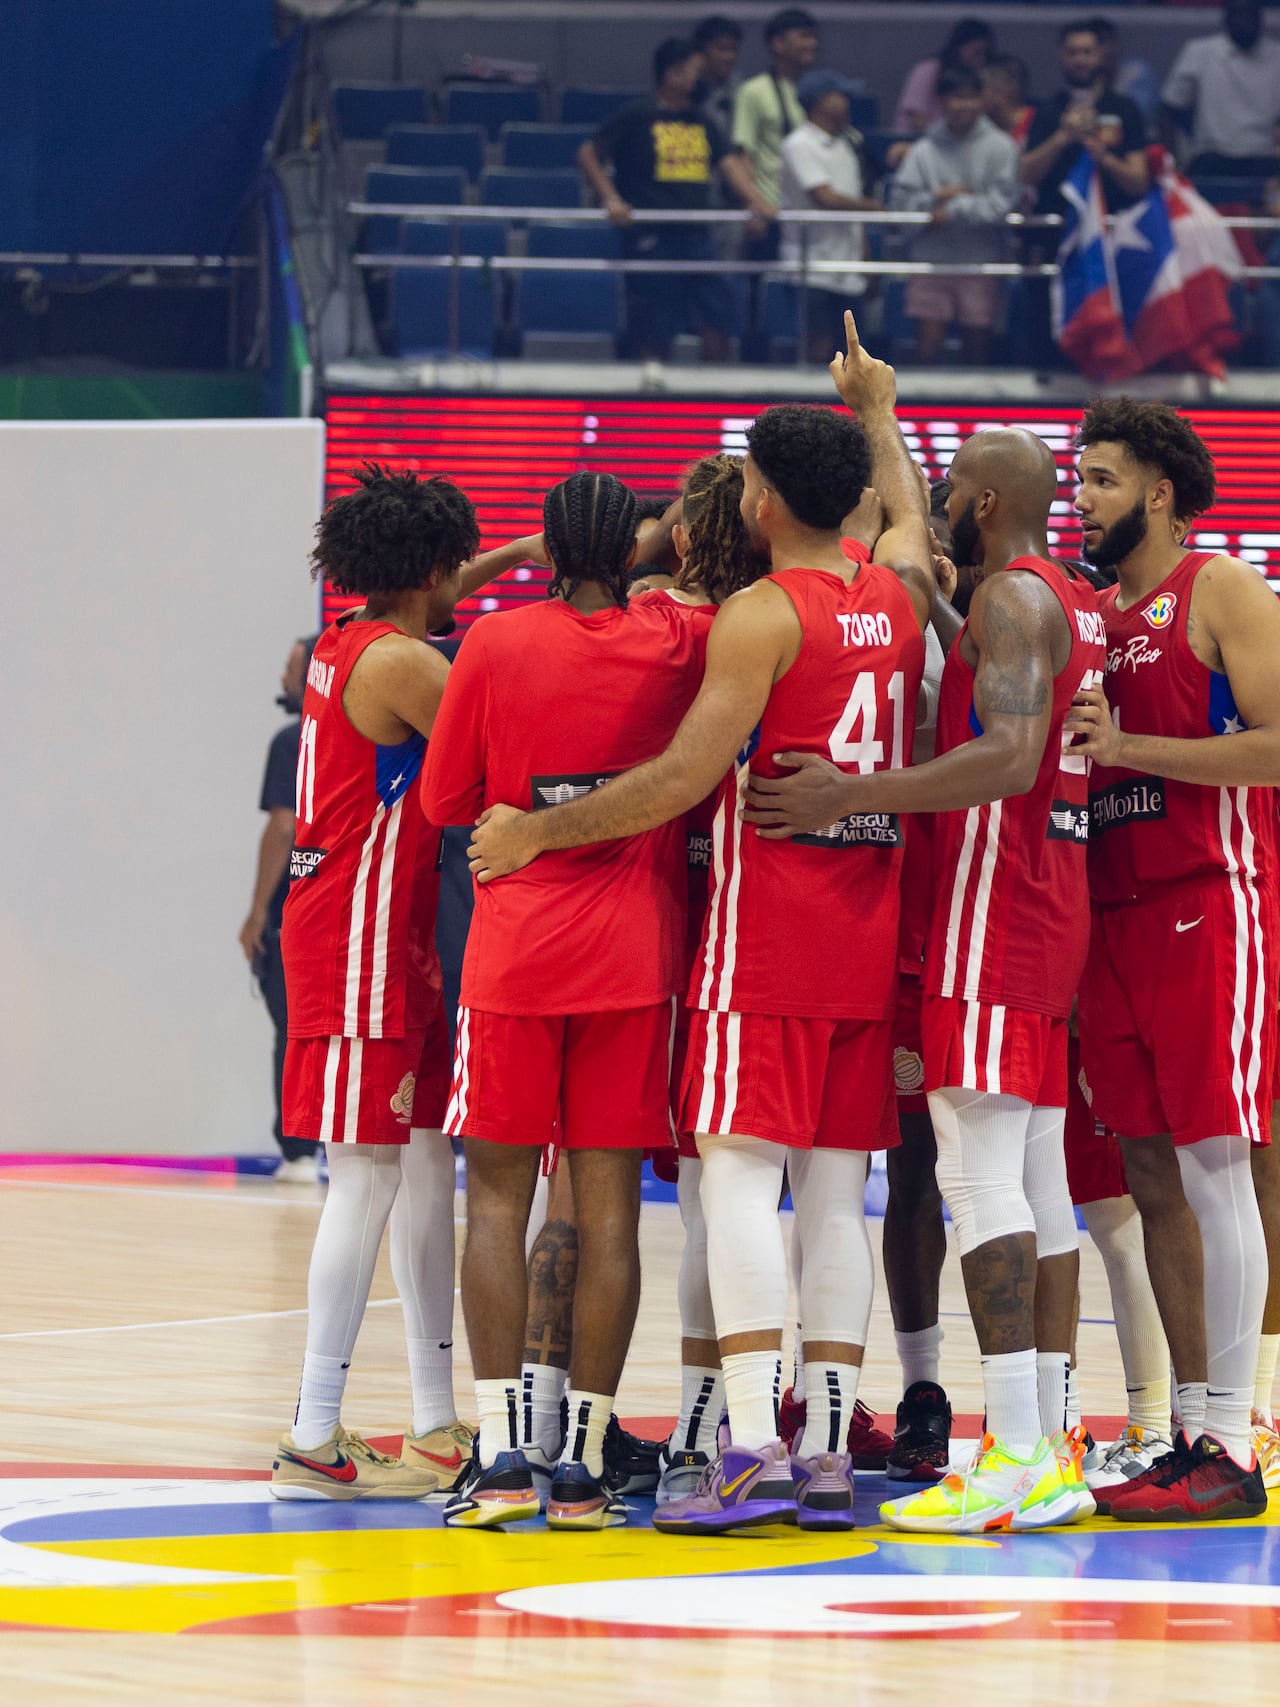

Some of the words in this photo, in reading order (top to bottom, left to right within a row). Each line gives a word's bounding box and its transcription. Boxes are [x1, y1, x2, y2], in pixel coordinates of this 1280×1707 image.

[836, 612, 892, 647] TORO
[1123, 635, 1162, 674] Rico
[828, 671, 904, 775] 41
[295, 714, 317, 825] 11
[685, 1455, 695, 1465] 12
